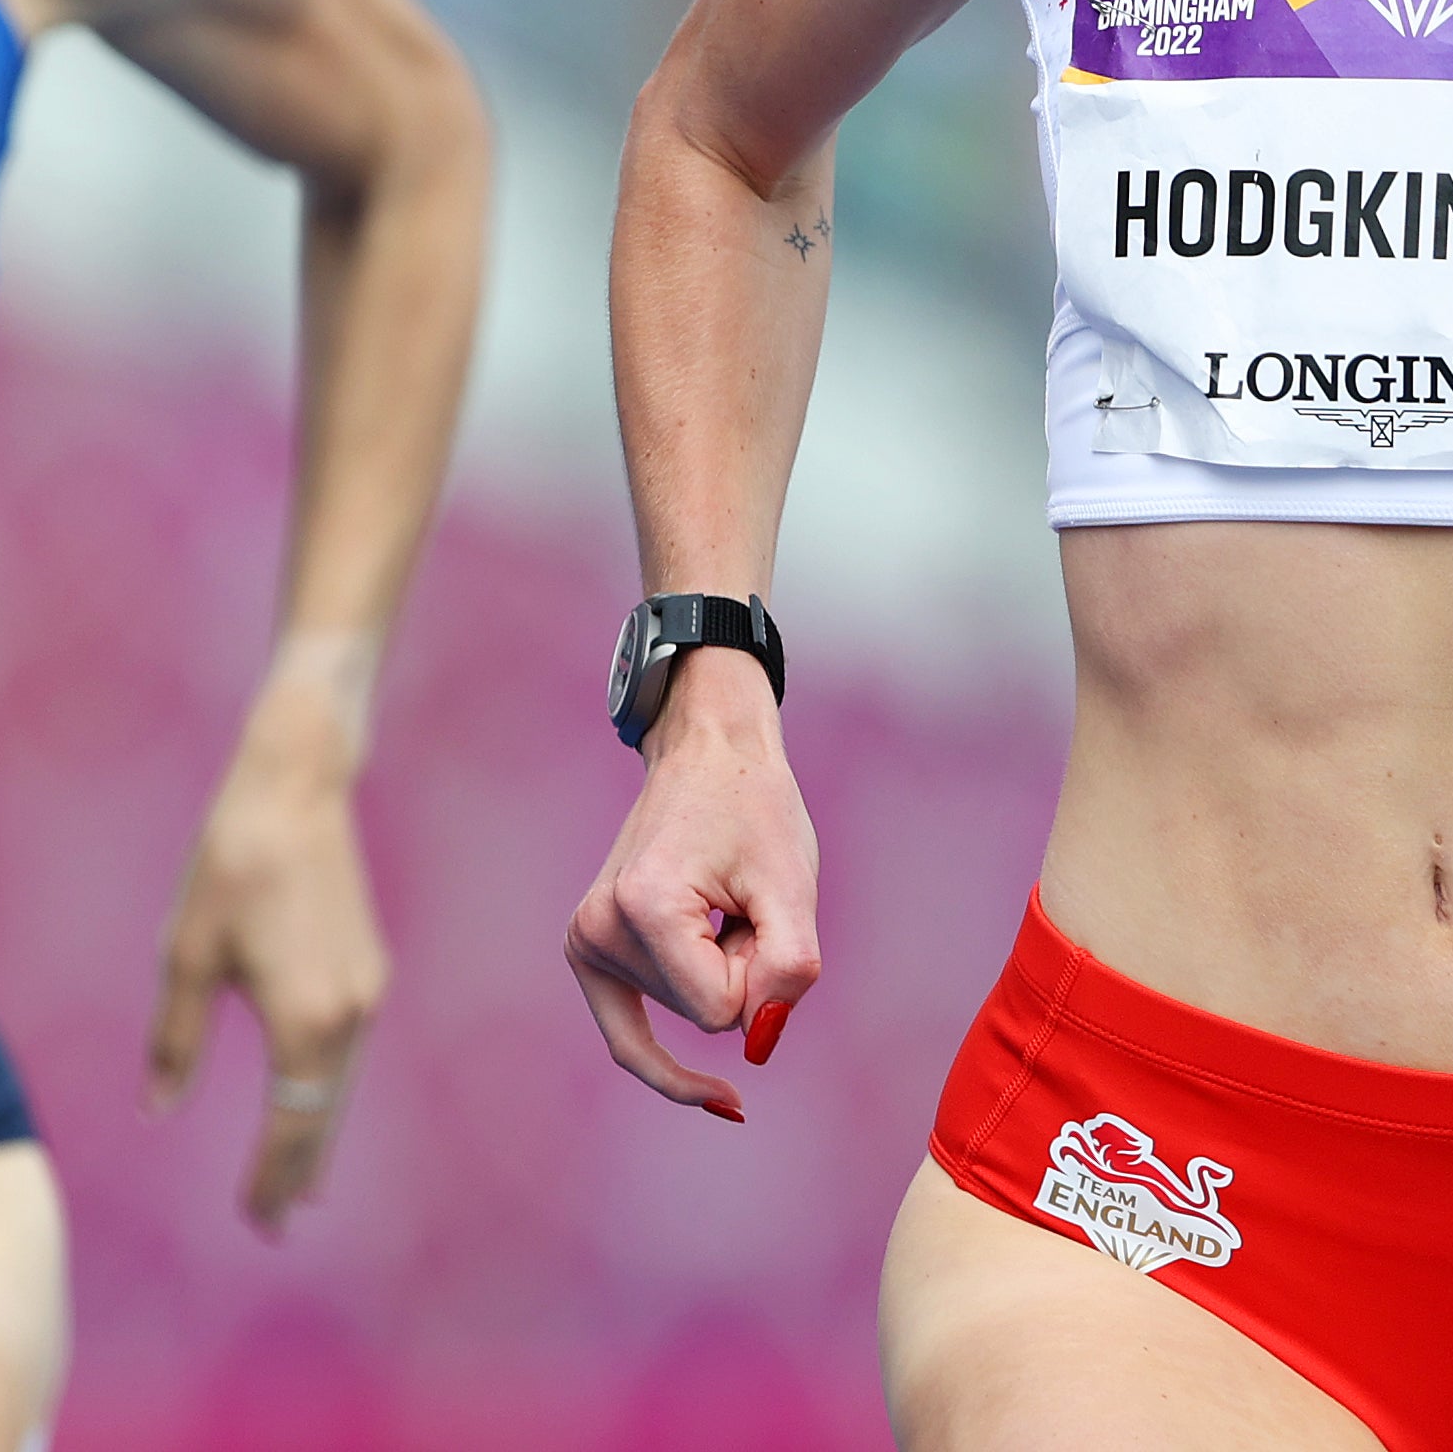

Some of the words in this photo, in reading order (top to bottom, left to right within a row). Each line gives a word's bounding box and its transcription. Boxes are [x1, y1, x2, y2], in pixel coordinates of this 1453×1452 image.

[1136, 22, 1204, 57] 2022
[1077, 1171, 1138, 1209] TEAM
[1048, 1179, 1223, 1259] ENGLAND
